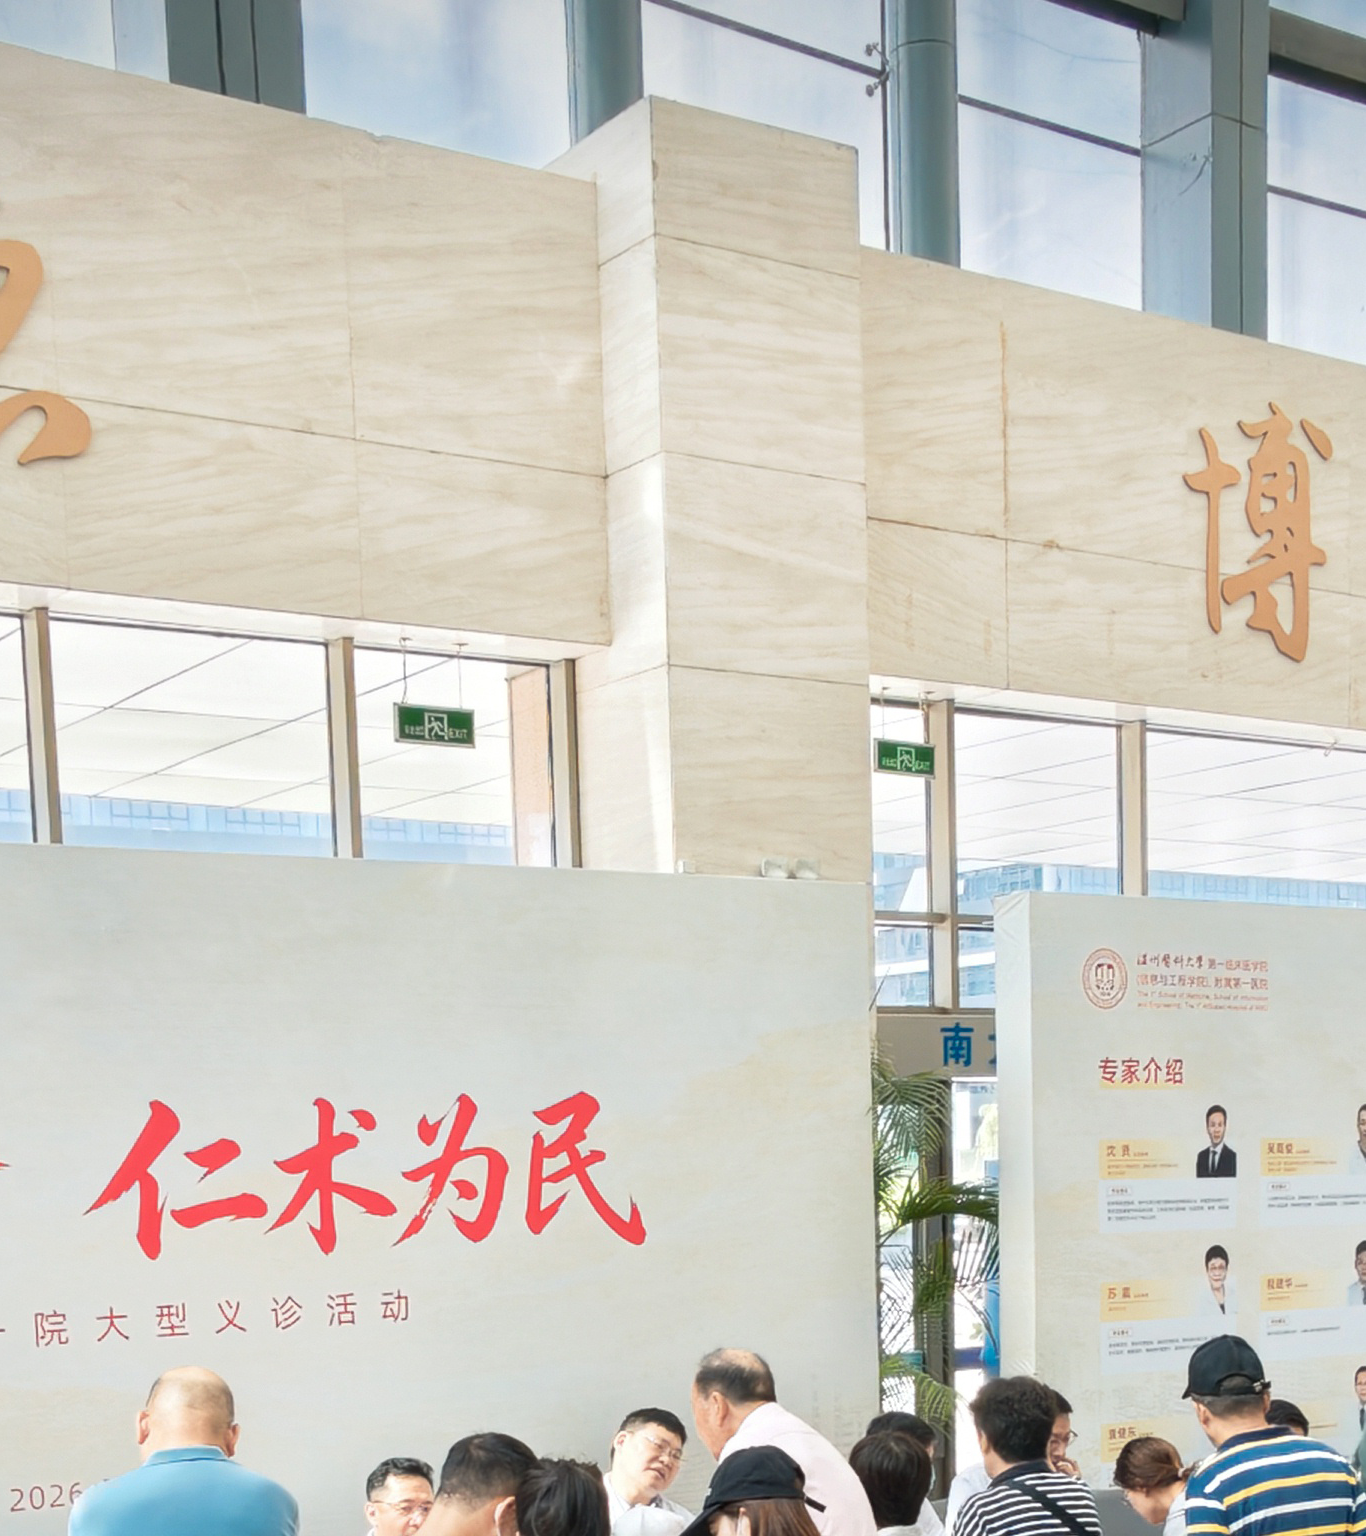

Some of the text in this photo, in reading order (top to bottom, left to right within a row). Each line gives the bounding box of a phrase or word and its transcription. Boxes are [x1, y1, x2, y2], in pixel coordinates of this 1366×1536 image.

[1098, 1057, 1184, 1085] 专家介绍
[88, 1091, 648, 1262] 仁术为民
